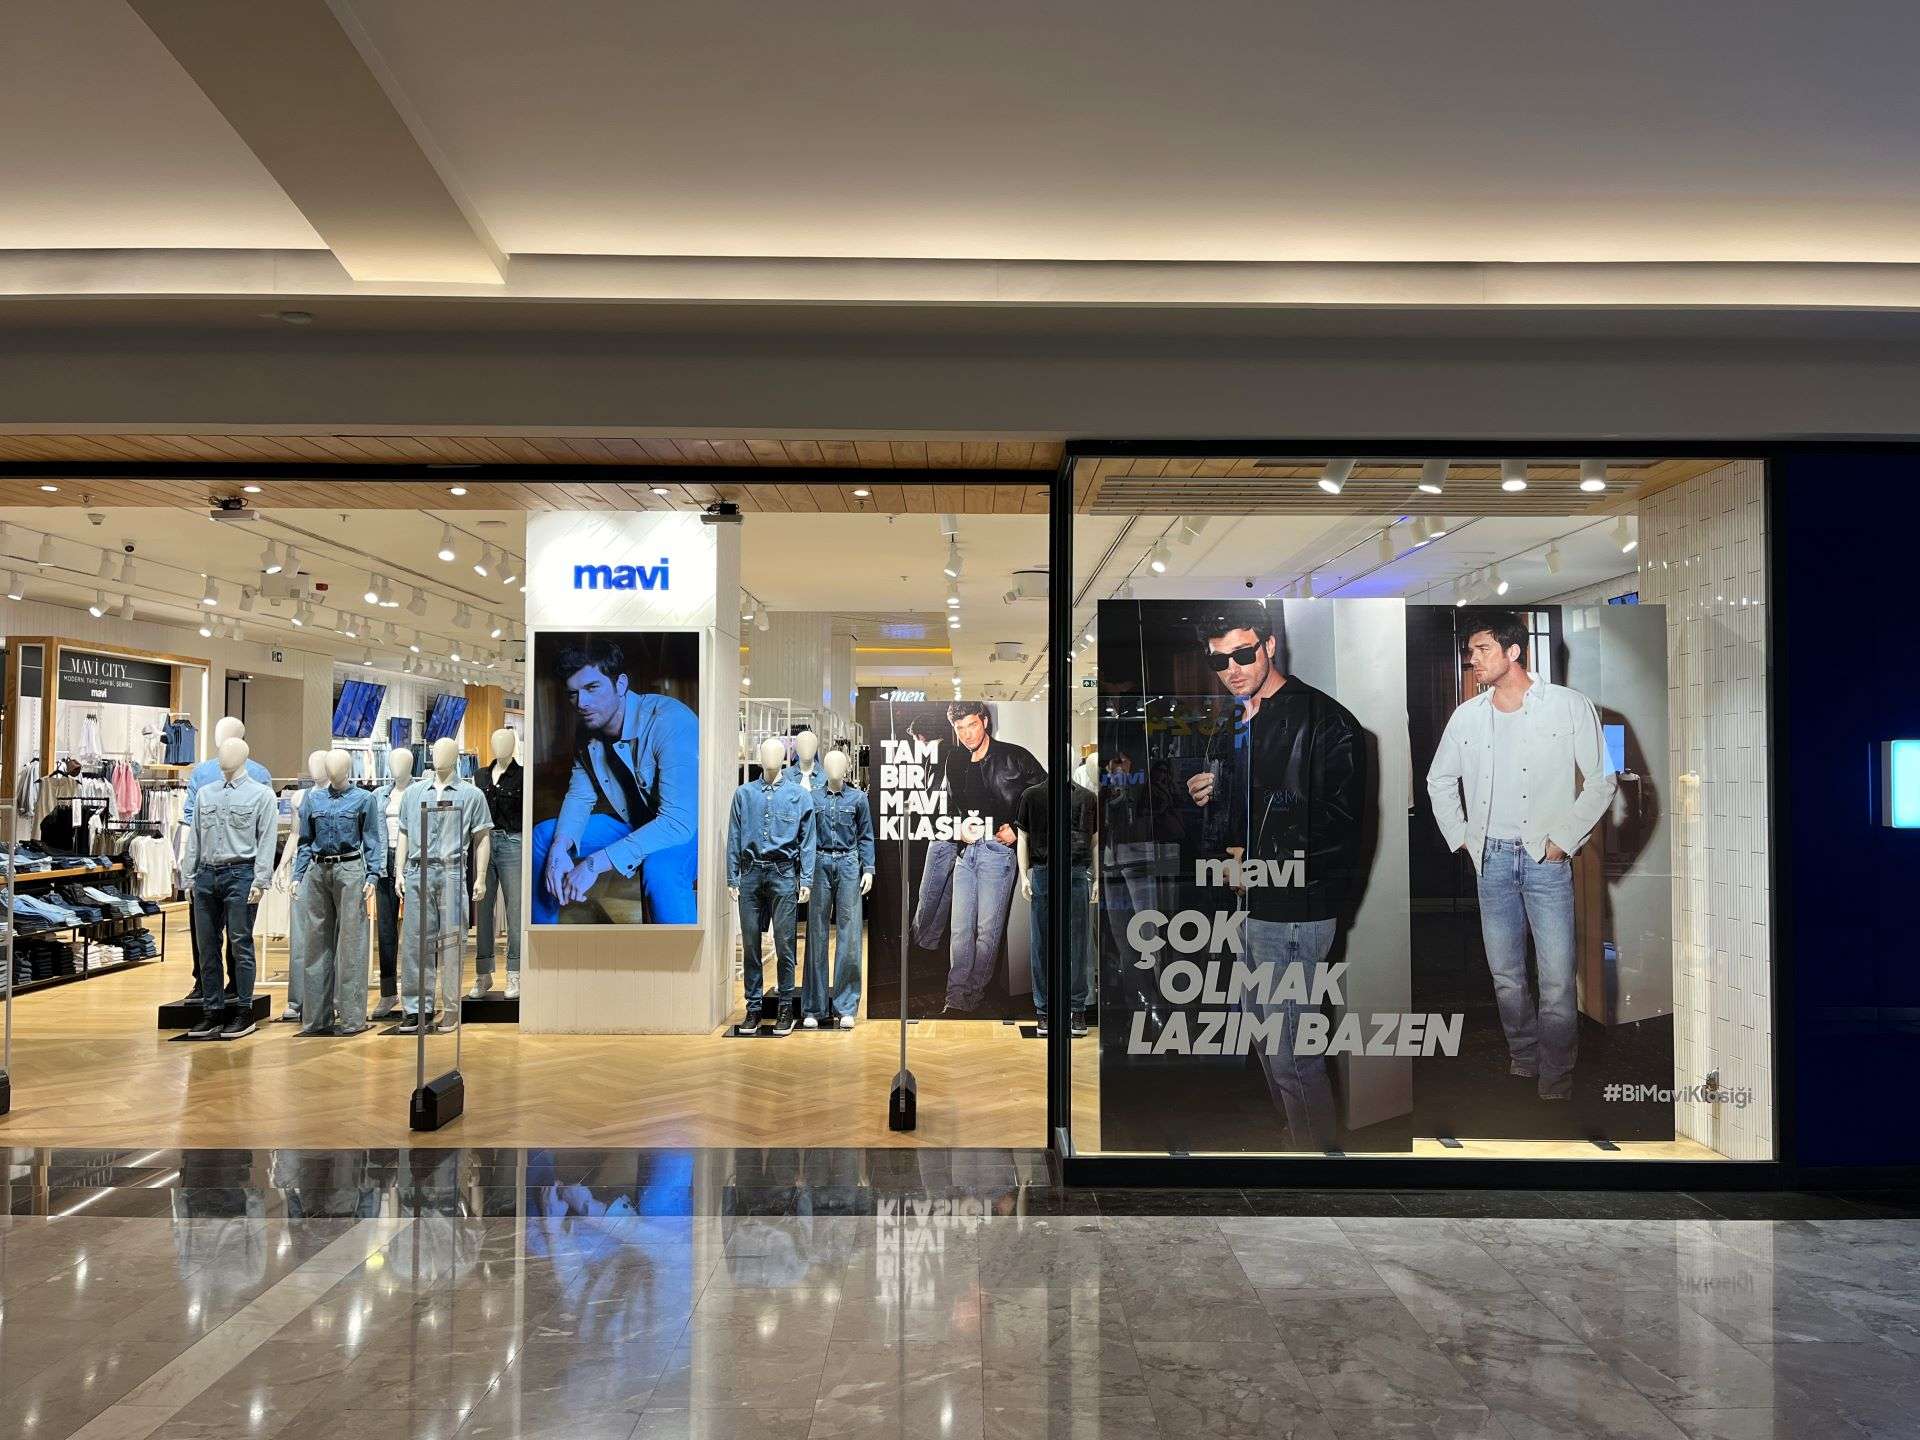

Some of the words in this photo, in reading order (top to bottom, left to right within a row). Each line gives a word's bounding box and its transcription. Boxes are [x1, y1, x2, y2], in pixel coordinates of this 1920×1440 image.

[574, 557, 669, 590] mavi
[102, 662, 127, 678] CITY
[91, 688, 107, 698] mavi
[890, 690, 925, 702] men
[880, 740, 939, 764] TAM
[1195, 850, 1305, 888] mavi
[1126, 909, 1251, 970] ÇOK
[1159, 960, 1351, 1006] OLMAK
[1127, 1011, 1285, 1056] LAZIM
[1293, 1013, 1465, 1057] BAZEN
